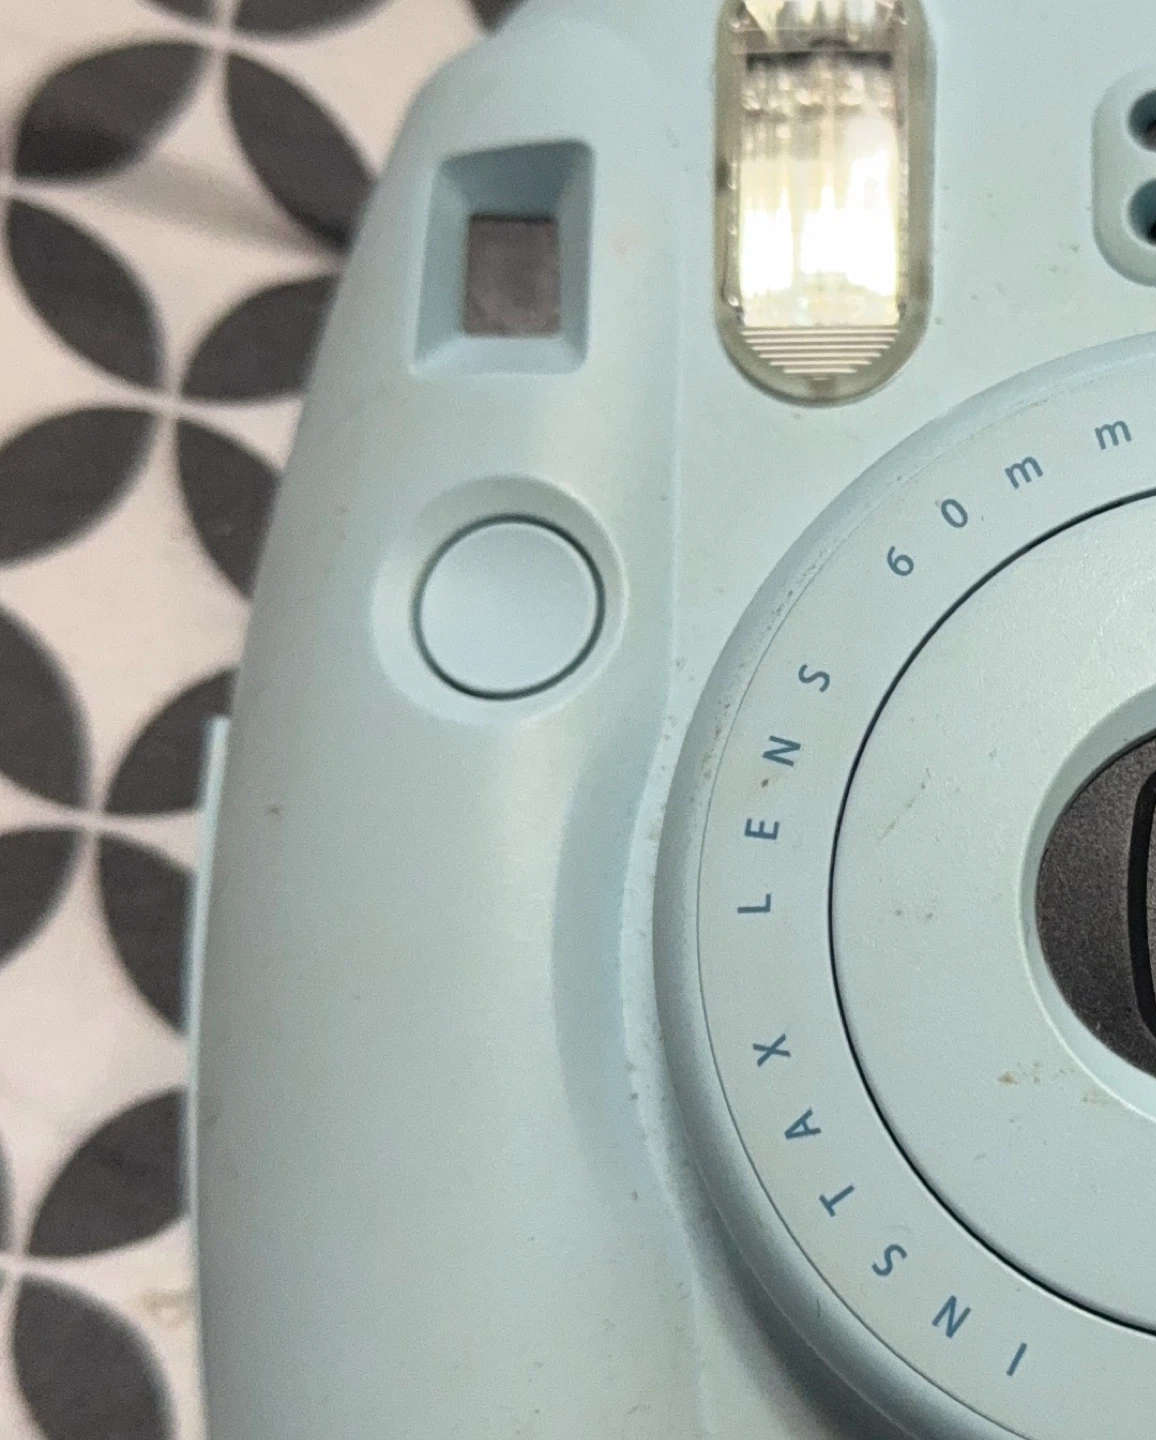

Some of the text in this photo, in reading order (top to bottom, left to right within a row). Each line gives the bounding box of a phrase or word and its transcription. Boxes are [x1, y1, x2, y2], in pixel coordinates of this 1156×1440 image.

[886, 418, 1133, 578] 60mm
[737, 664, 831, 915] LENS
[752, 1033, 1028, 1377] INSTAX
